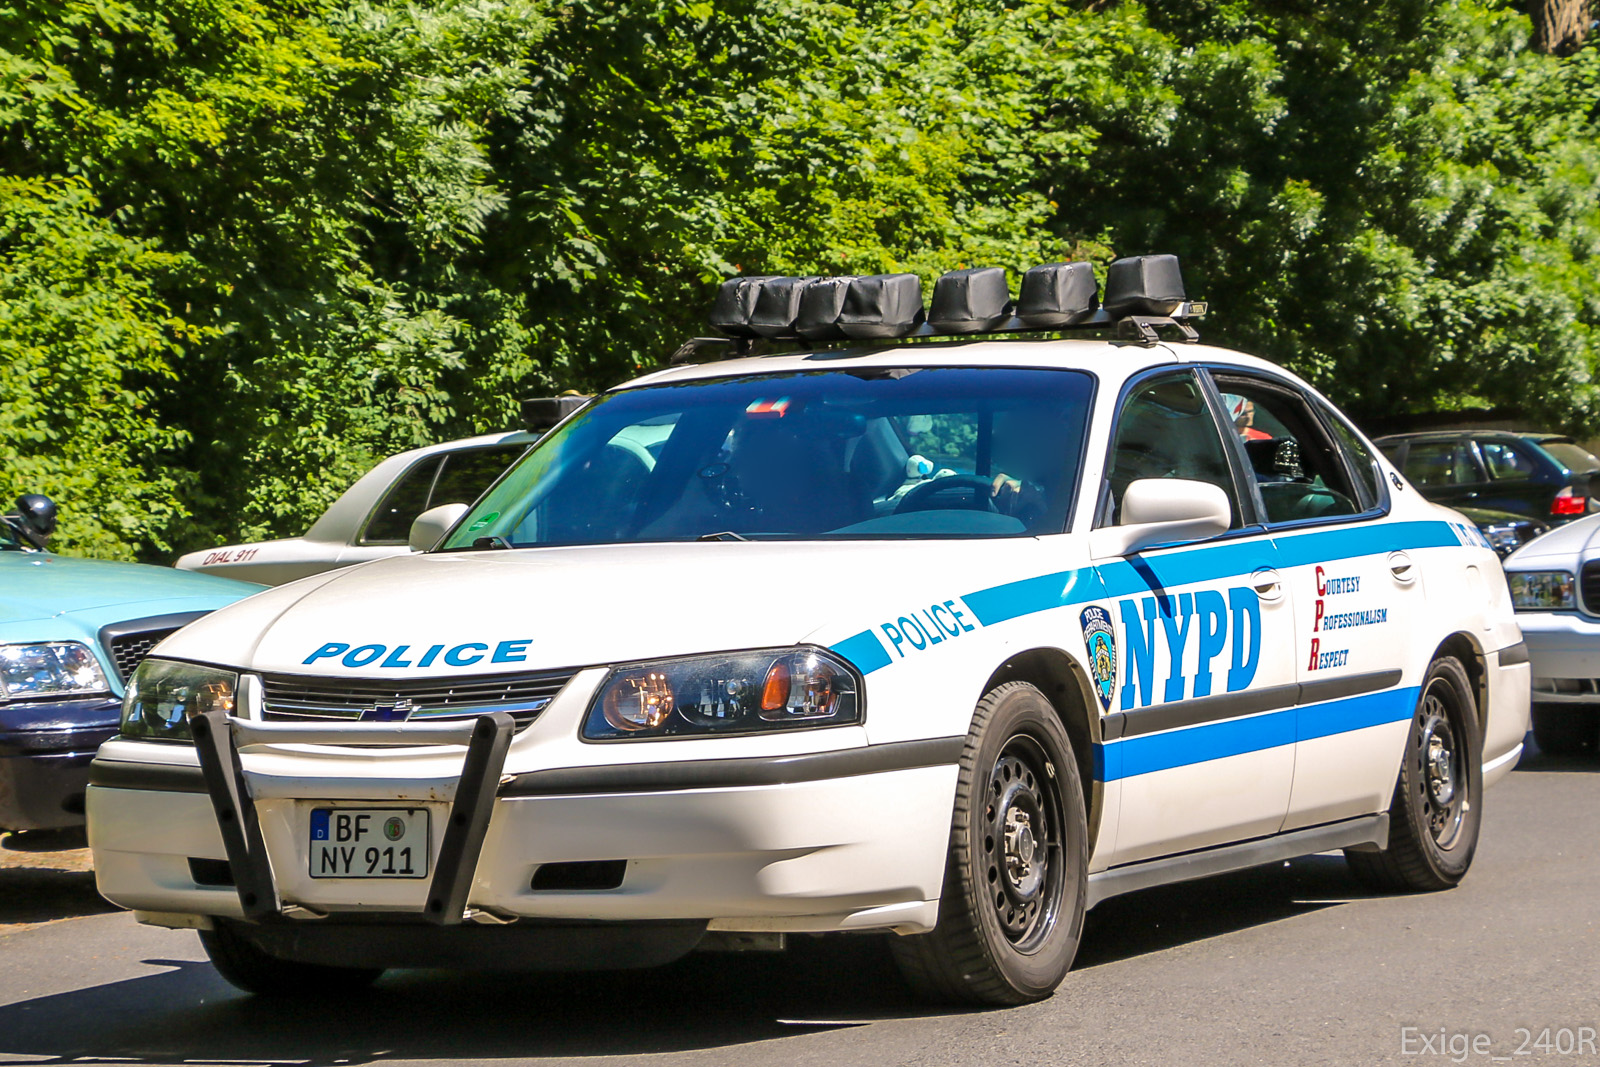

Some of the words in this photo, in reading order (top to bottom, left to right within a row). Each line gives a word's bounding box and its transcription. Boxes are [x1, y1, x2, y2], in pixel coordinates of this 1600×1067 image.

[202, 551, 233, 565] DIAL
[233, 548, 259, 562] 911
[1315, 565, 1361, 597] COURTESY
[880, 599, 976, 658] POLICE
[1084, 608, 1103, 622] POLICE
[1313, 599, 1388, 632] PROFESSIONALISM
[301, 639, 534, 668] POLICE
[1119, 586, 1261, 711] NYPD
[1307, 637, 1350, 672] RESPECT
[336, 814, 371, 842] BF
[321, 846, 356, 874] NY
[364, 846, 414, 874] 911
